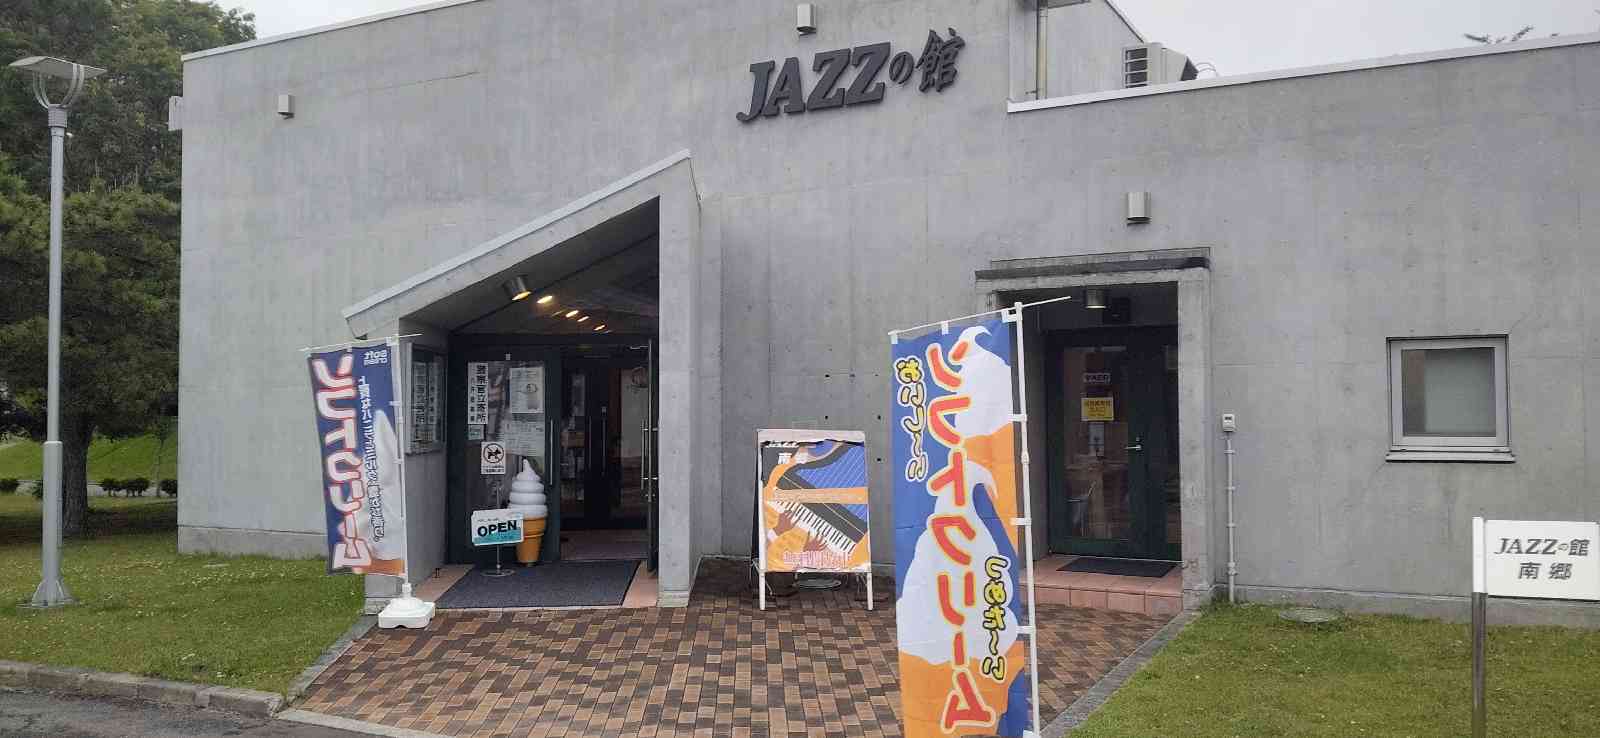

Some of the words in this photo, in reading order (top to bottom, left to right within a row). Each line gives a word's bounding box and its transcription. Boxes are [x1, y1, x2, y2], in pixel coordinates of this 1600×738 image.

[736, 28, 966, 122] JAZZの館
[478, 520, 517, 537] OPEN
[1494, 537, 1590, 556] JAZZの館
